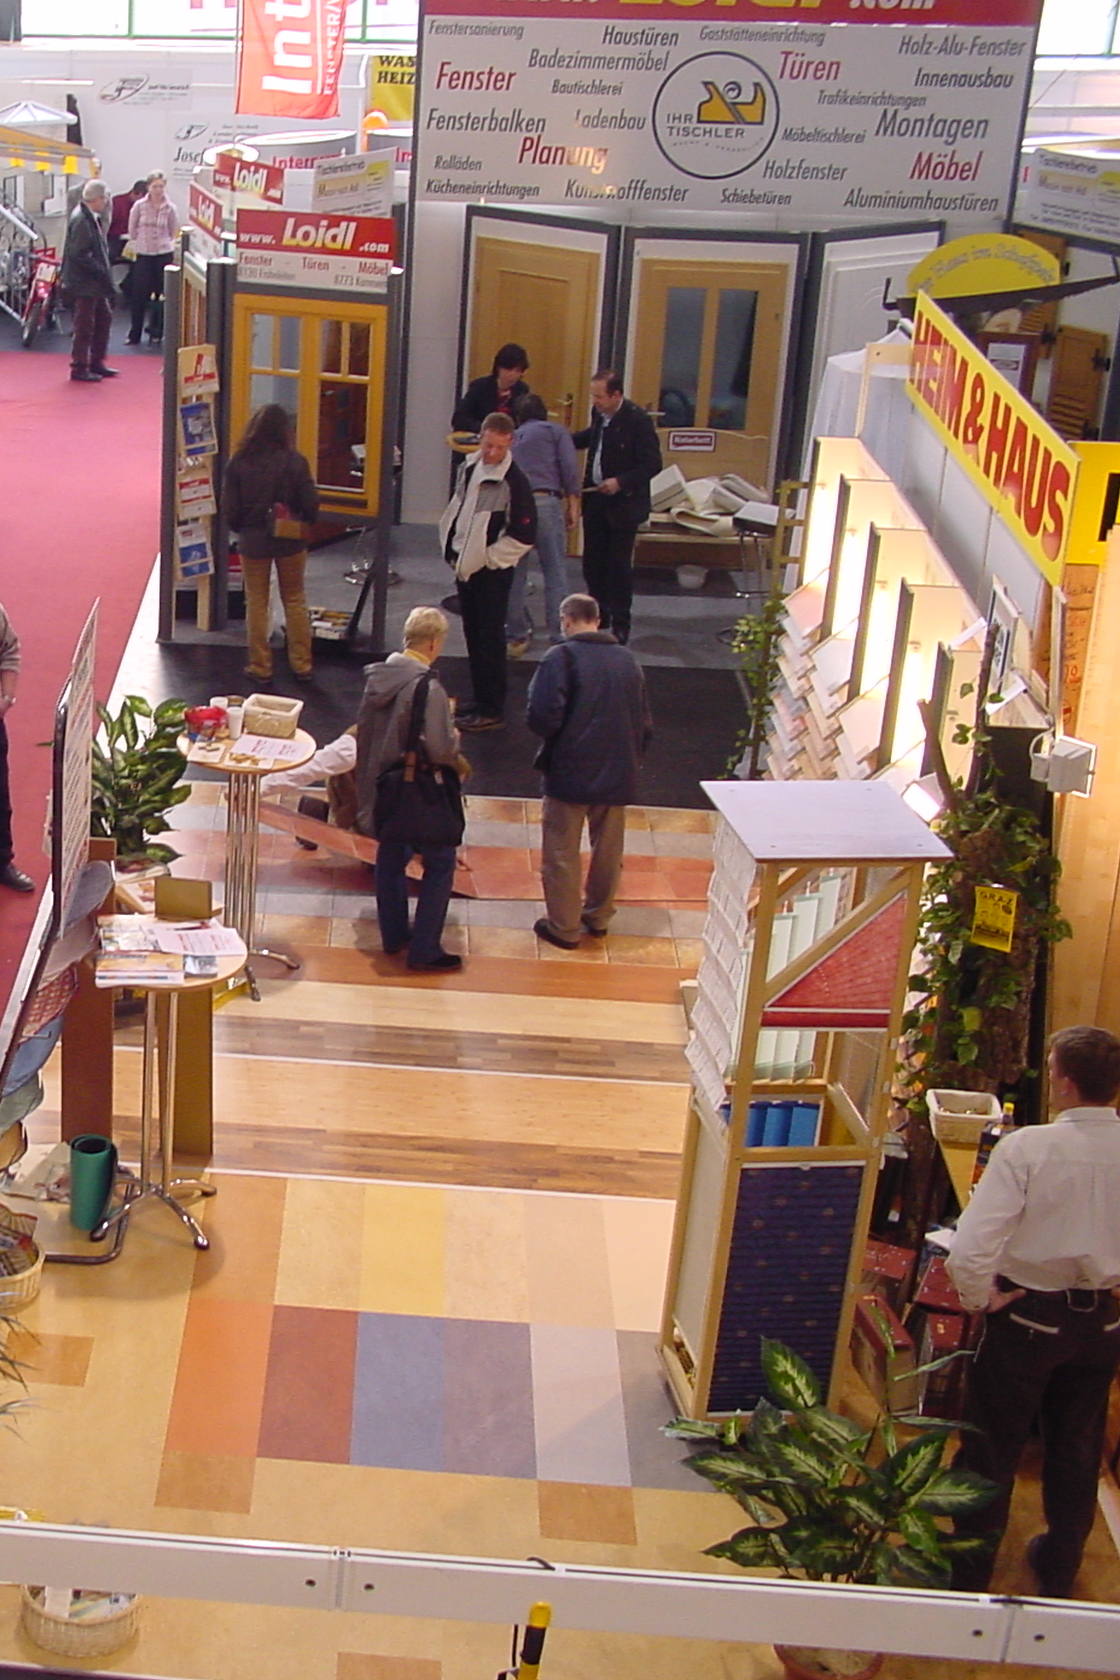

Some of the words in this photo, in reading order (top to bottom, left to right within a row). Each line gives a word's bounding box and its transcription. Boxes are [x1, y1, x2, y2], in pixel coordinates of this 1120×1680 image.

[428, 20, 525, 40] Fenstersanierung
[602, 25, 679, 46] Haustüren
[898, 33, 1026, 57] Holz-Alu-Fenster
[528, 48, 670, 72] Badezimmermöbel
[778, 50, 841, 81] Türen
[436, 61, 517, 91] Fenster
[551, 79, 623, 96] Bautischlerei
[914, 67, 1014, 88] Innenausbau
[426, 108, 546, 133] Fensterbalken
[666, 113, 694, 124] IHR
[874, 108, 989, 146] Montagen
[667, 126, 746, 139] TISCHLER
[781, 127, 866, 144] Möbeltischlerei
[518, 135, 609, 175] Planung
[908, 150, 983, 182] Möbel
[762, 158, 847, 183] Holzfenster
[425, 179, 540, 199] Kücheneinrichtungen
[720, 187, 792, 206] Schiebetüren
[843, 187, 999, 212] Aluminiumhaustüren
[238, 233, 276, 245] www.
[282, 218, 357, 250] Loidl
[359, 242, 390, 254] .com
[239, 252, 273, 266] Fenster
[302, 256, 330, 271] Türen
[358, 261, 389, 275] Möbel
[910, 309, 969, 440] HEIM
[961, 372, 986, 468] &
[982, 390, 1072, 562] HAUS
